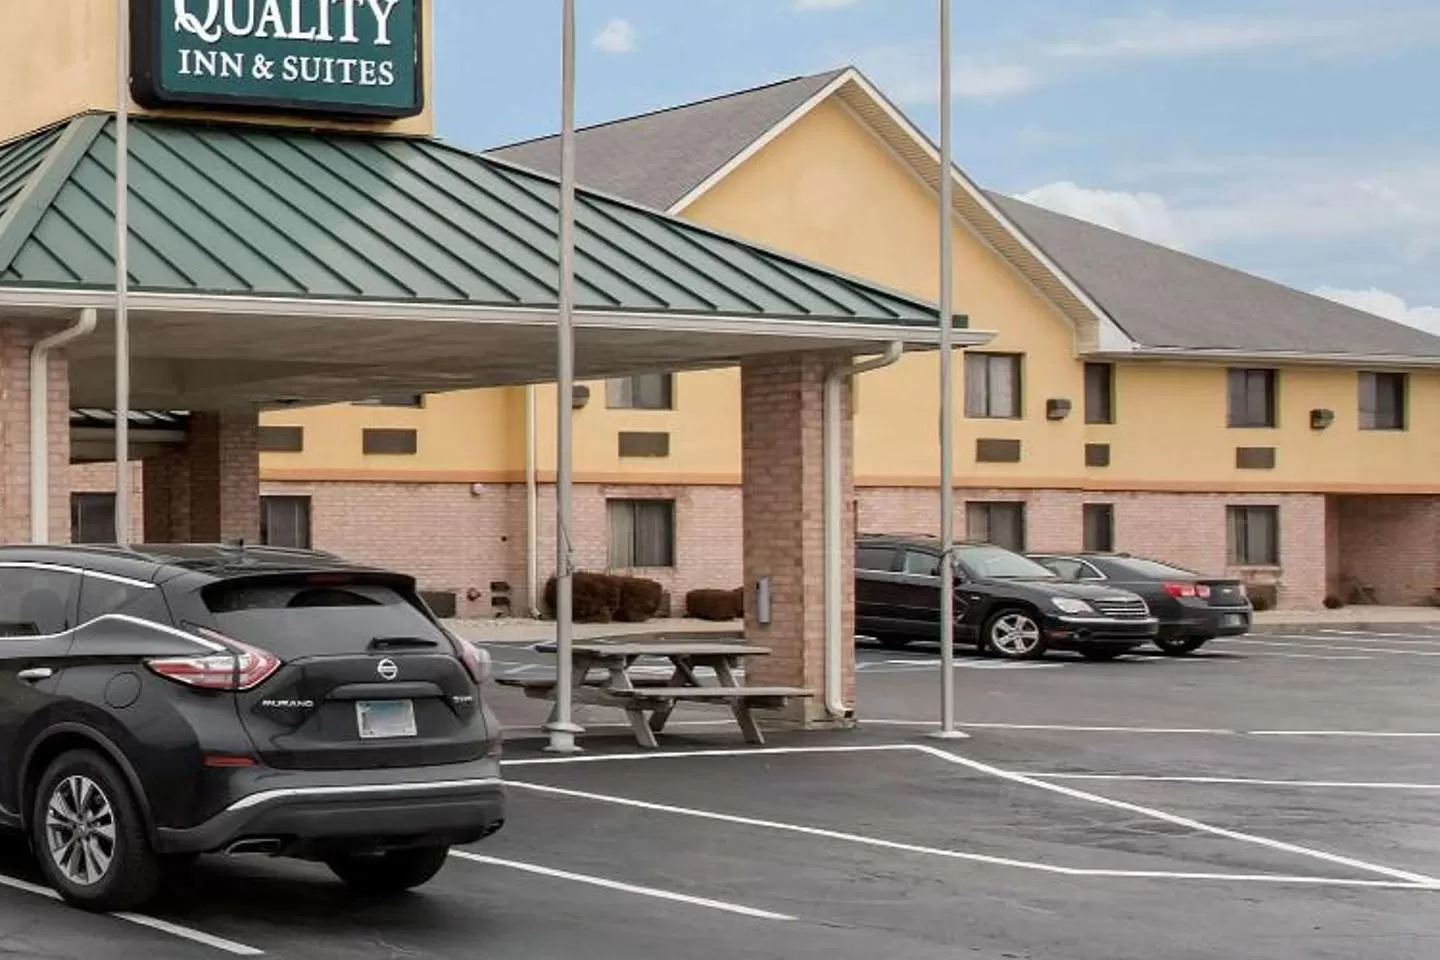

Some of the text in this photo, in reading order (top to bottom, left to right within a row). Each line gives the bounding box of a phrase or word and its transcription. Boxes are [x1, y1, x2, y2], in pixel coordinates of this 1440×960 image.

[178, 49, 395, 86] INN & SUITES
